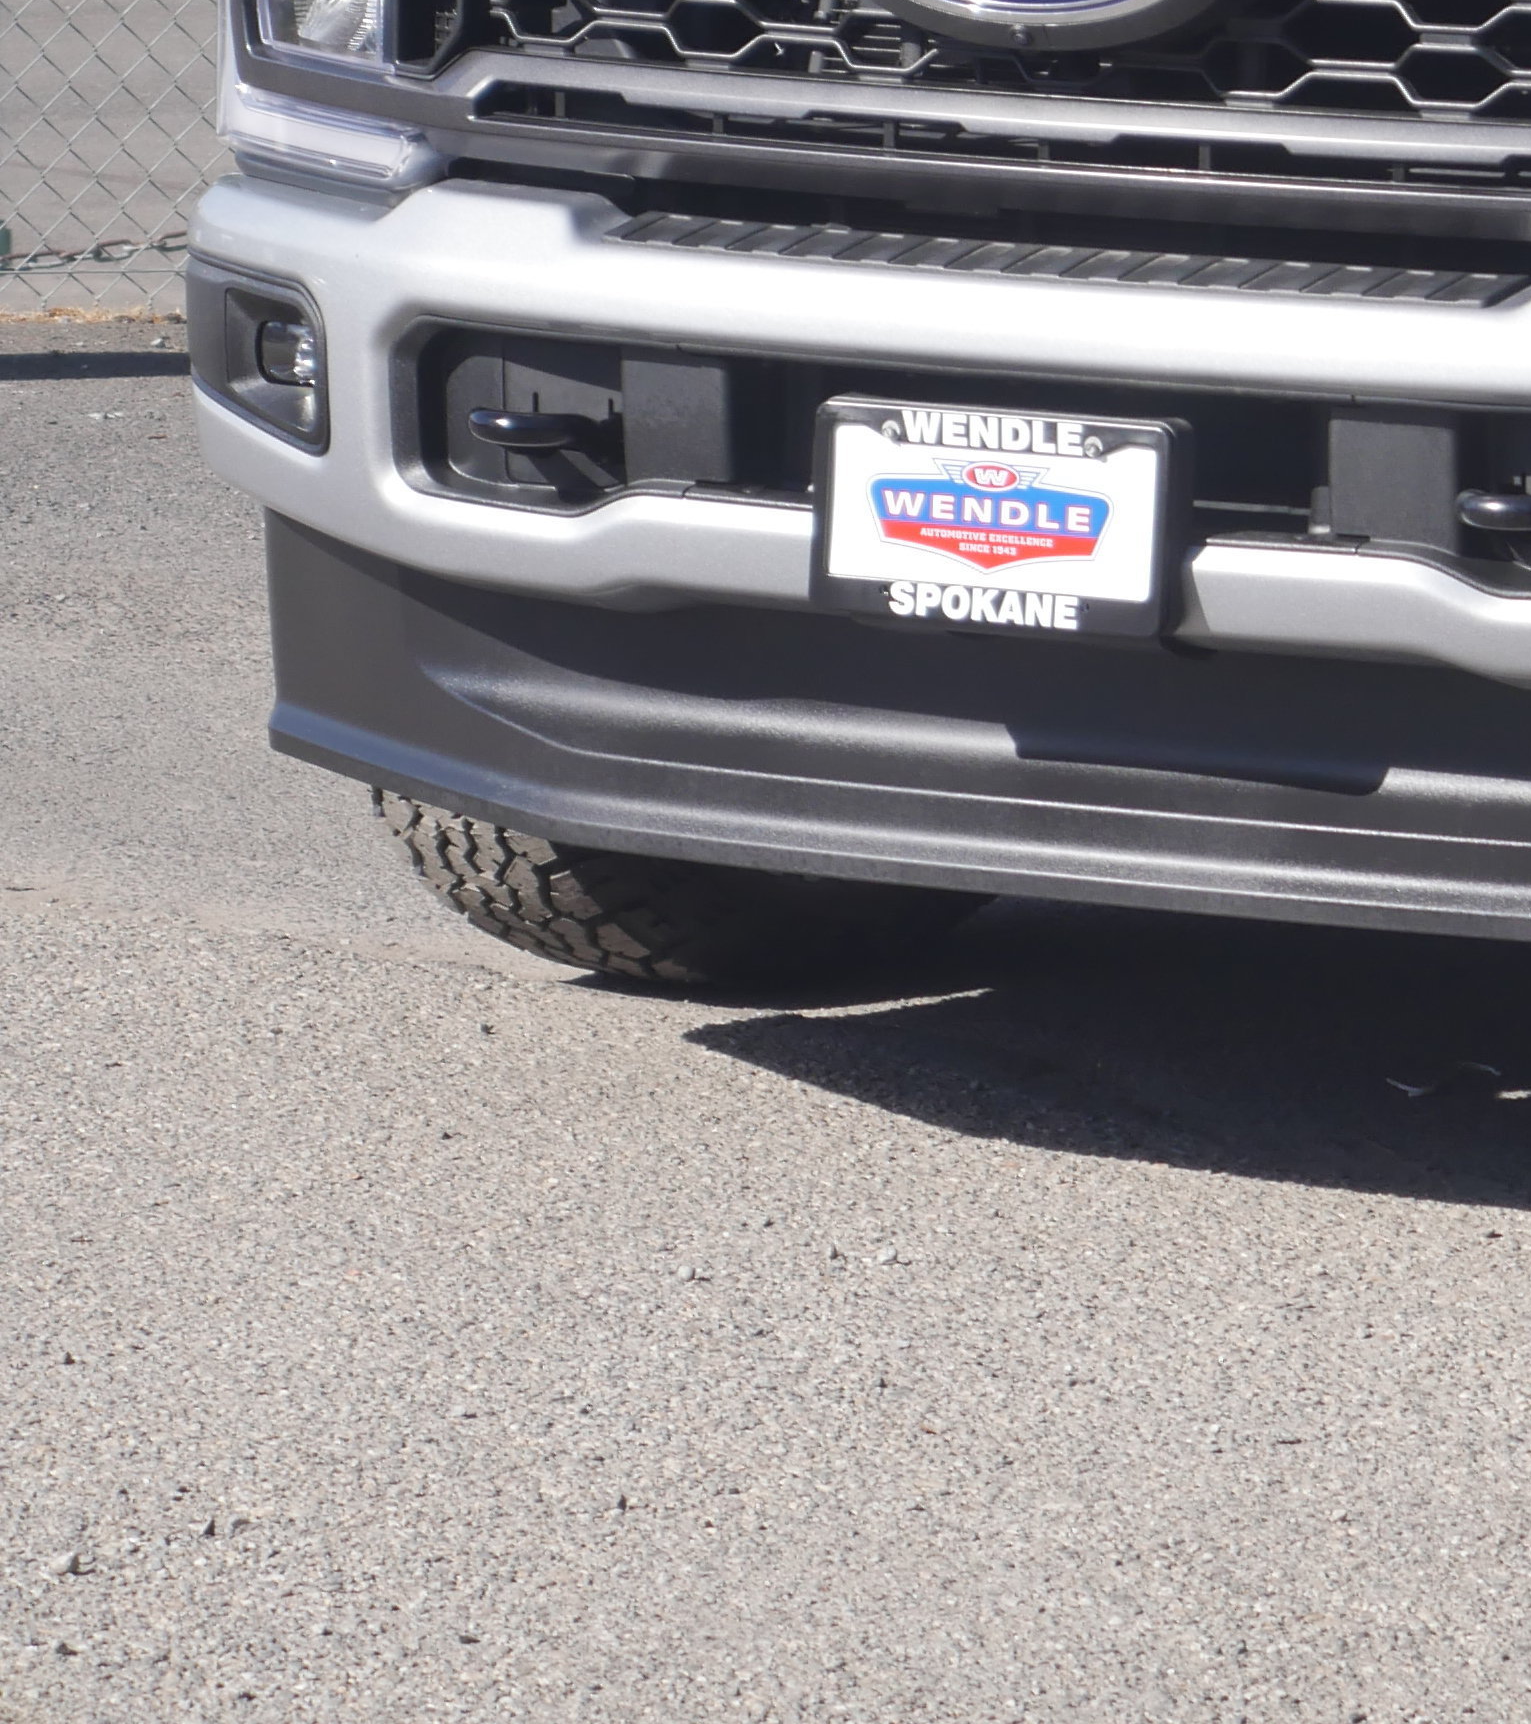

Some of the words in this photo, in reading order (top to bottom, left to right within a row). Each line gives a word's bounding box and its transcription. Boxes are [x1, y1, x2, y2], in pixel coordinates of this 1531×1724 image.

[902, 410, 1084, 457] WENDLE
[883, 490, 1091, 532] WENDLE
[920, 527, 986, 542] AUTOMOTIVE
[988, 532, 1053, 548] EXCELLENCE
[959, 542, 990, 553] SINCE
[992, 545, 1017, 556] 1943
[888, 581, 1079, 630] SPOKANE
